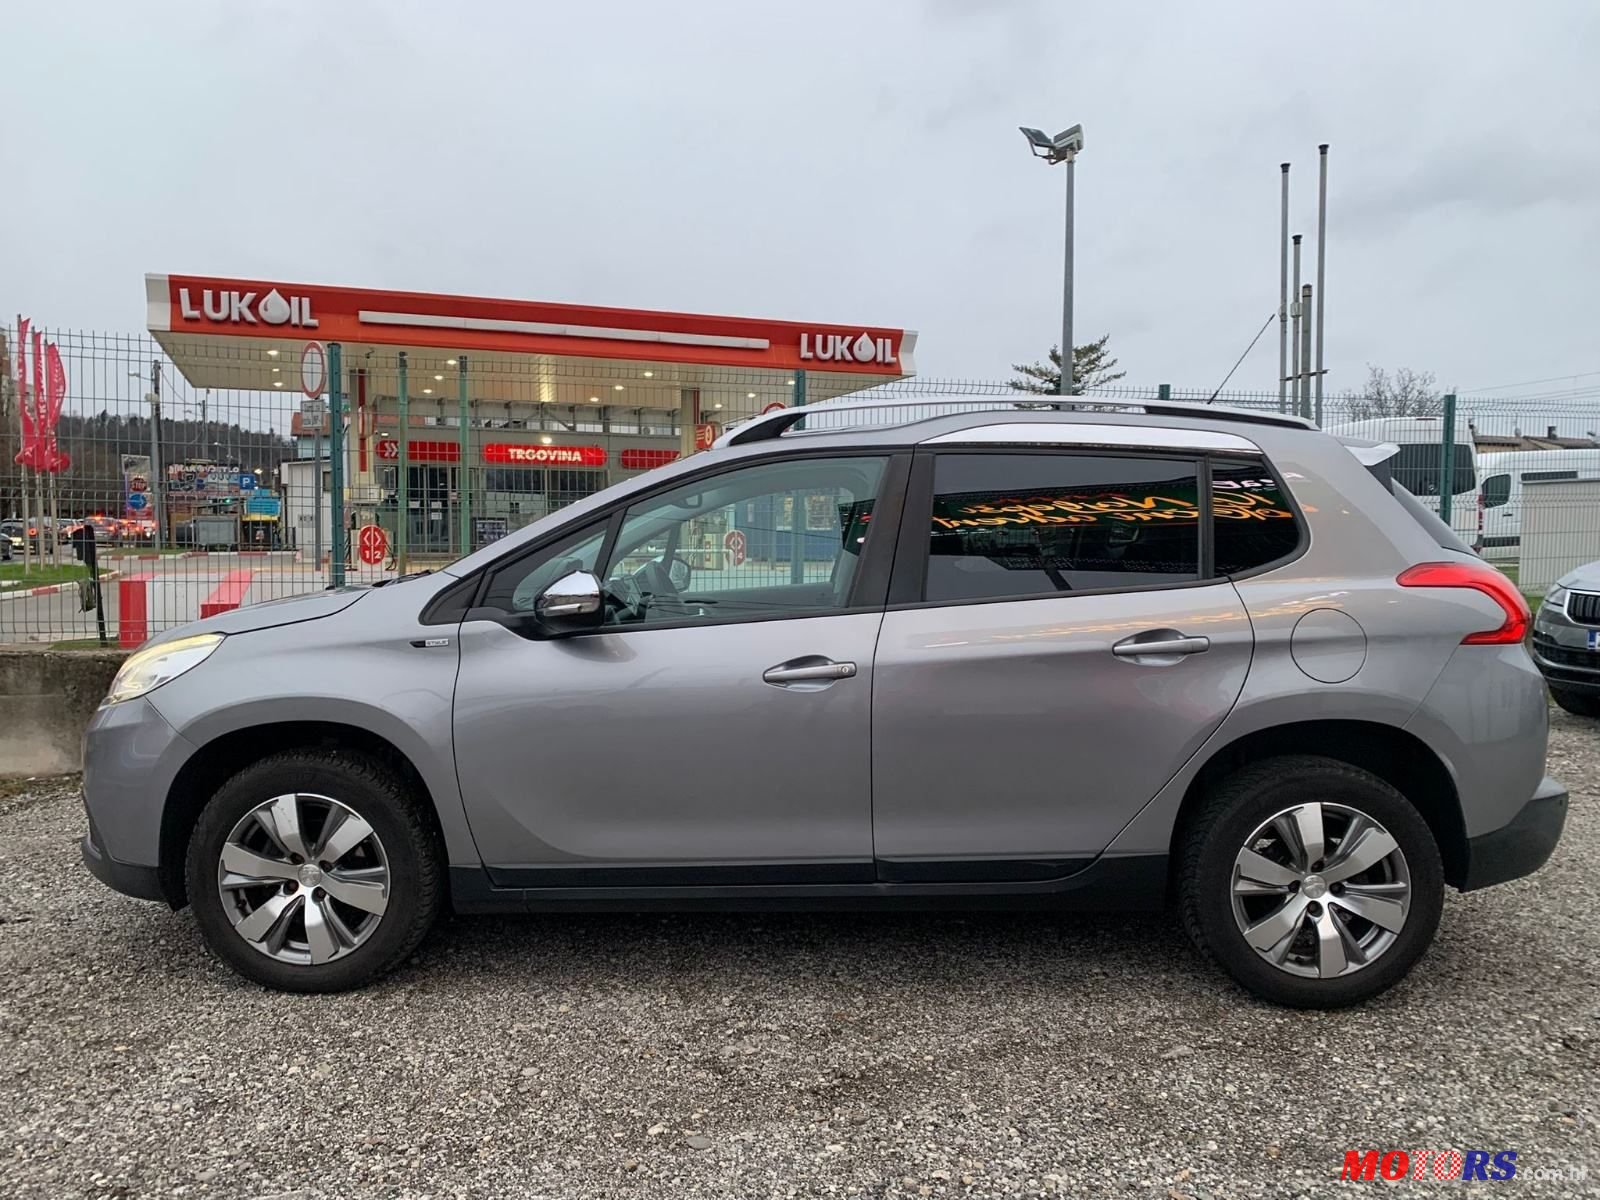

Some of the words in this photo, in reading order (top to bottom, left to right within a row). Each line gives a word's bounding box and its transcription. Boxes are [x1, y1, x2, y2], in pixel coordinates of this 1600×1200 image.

[179, 288, 319, 327] LUKOIL
[800, 331, 897, 363] LUKOIL
[508, 448, 582, 462] TRGOVINA
[242, 477, 251, 488] P
[374, 550, 382, 559] 2
